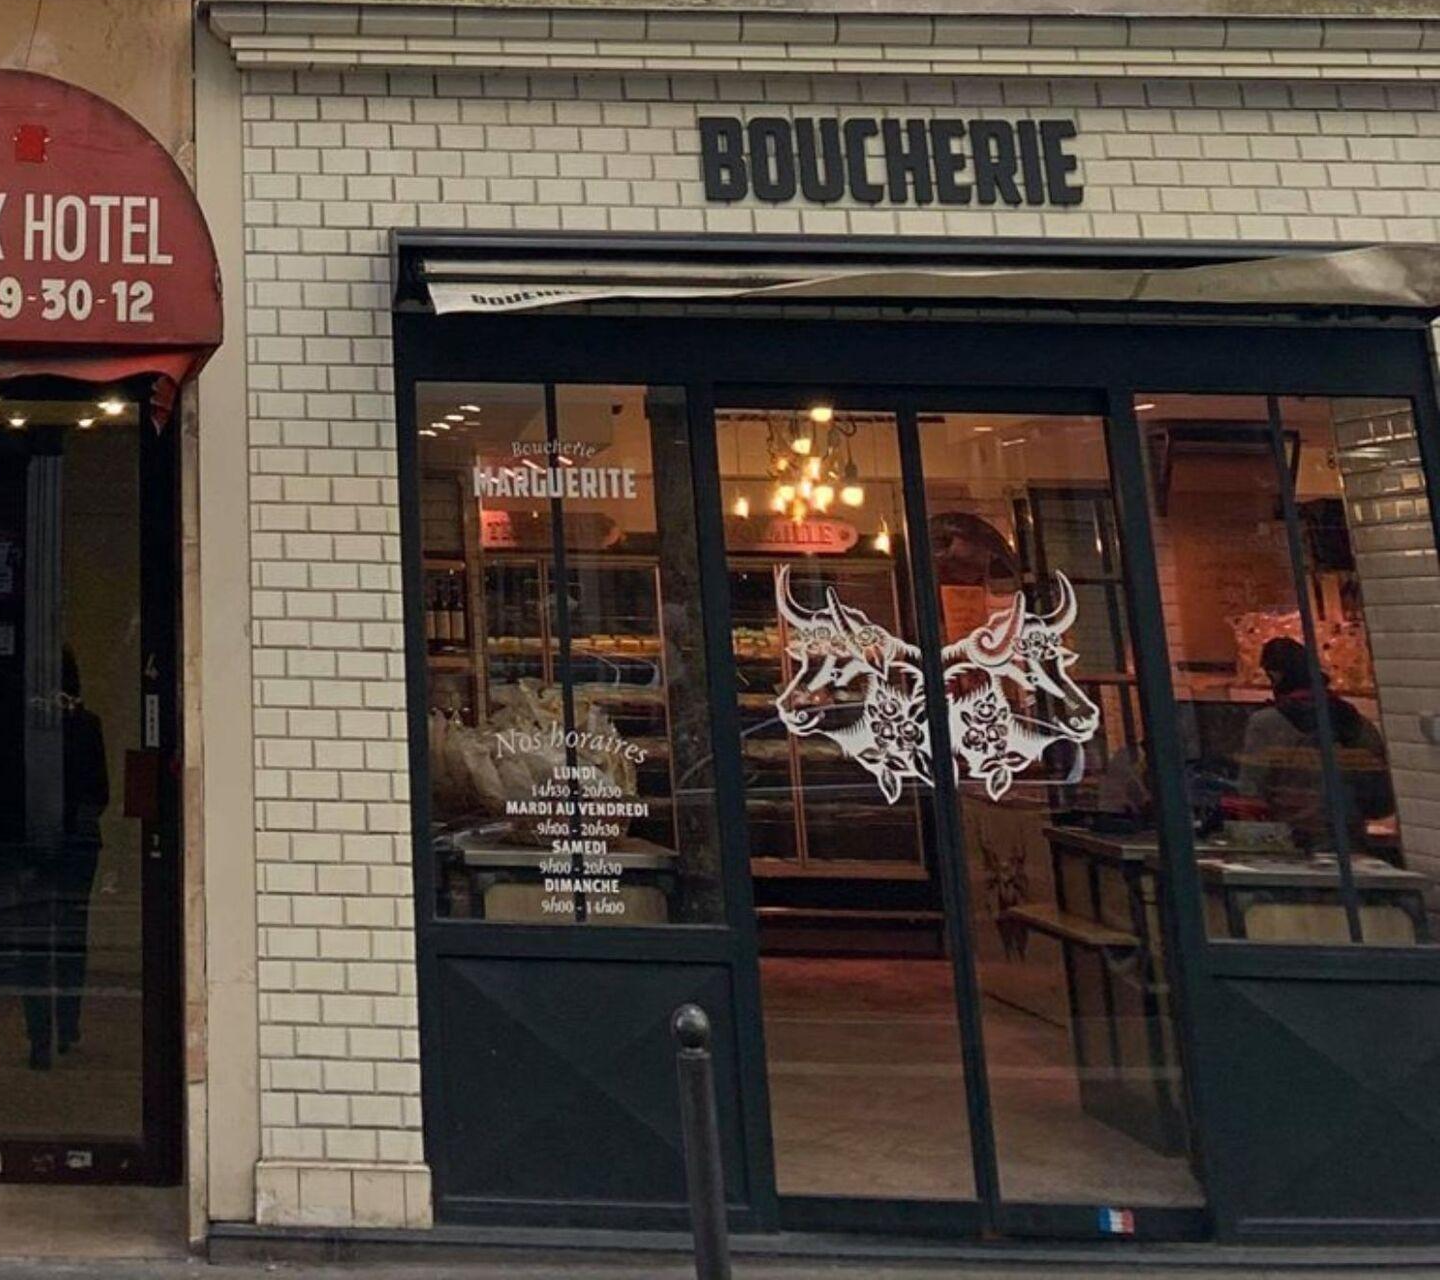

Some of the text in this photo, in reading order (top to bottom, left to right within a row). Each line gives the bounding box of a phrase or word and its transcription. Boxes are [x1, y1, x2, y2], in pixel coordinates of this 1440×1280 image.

[698, 116, 1084, 206] BOUCHERIE
[24, 193, 173, 265] HOTEL
[512, 440, 596, 457] Boucherie
[473, 467, 637, 499] MARGUERITE
[496, 721, 649, 764] Nos horaires
[553, 766, 596, 780] LUNDI
[506, 802, 649, 817] MARDI AU VENDREDI
[552, 841, 607, 855] SAMEDI
[544, 878, 620, 892] DIMANCHE
